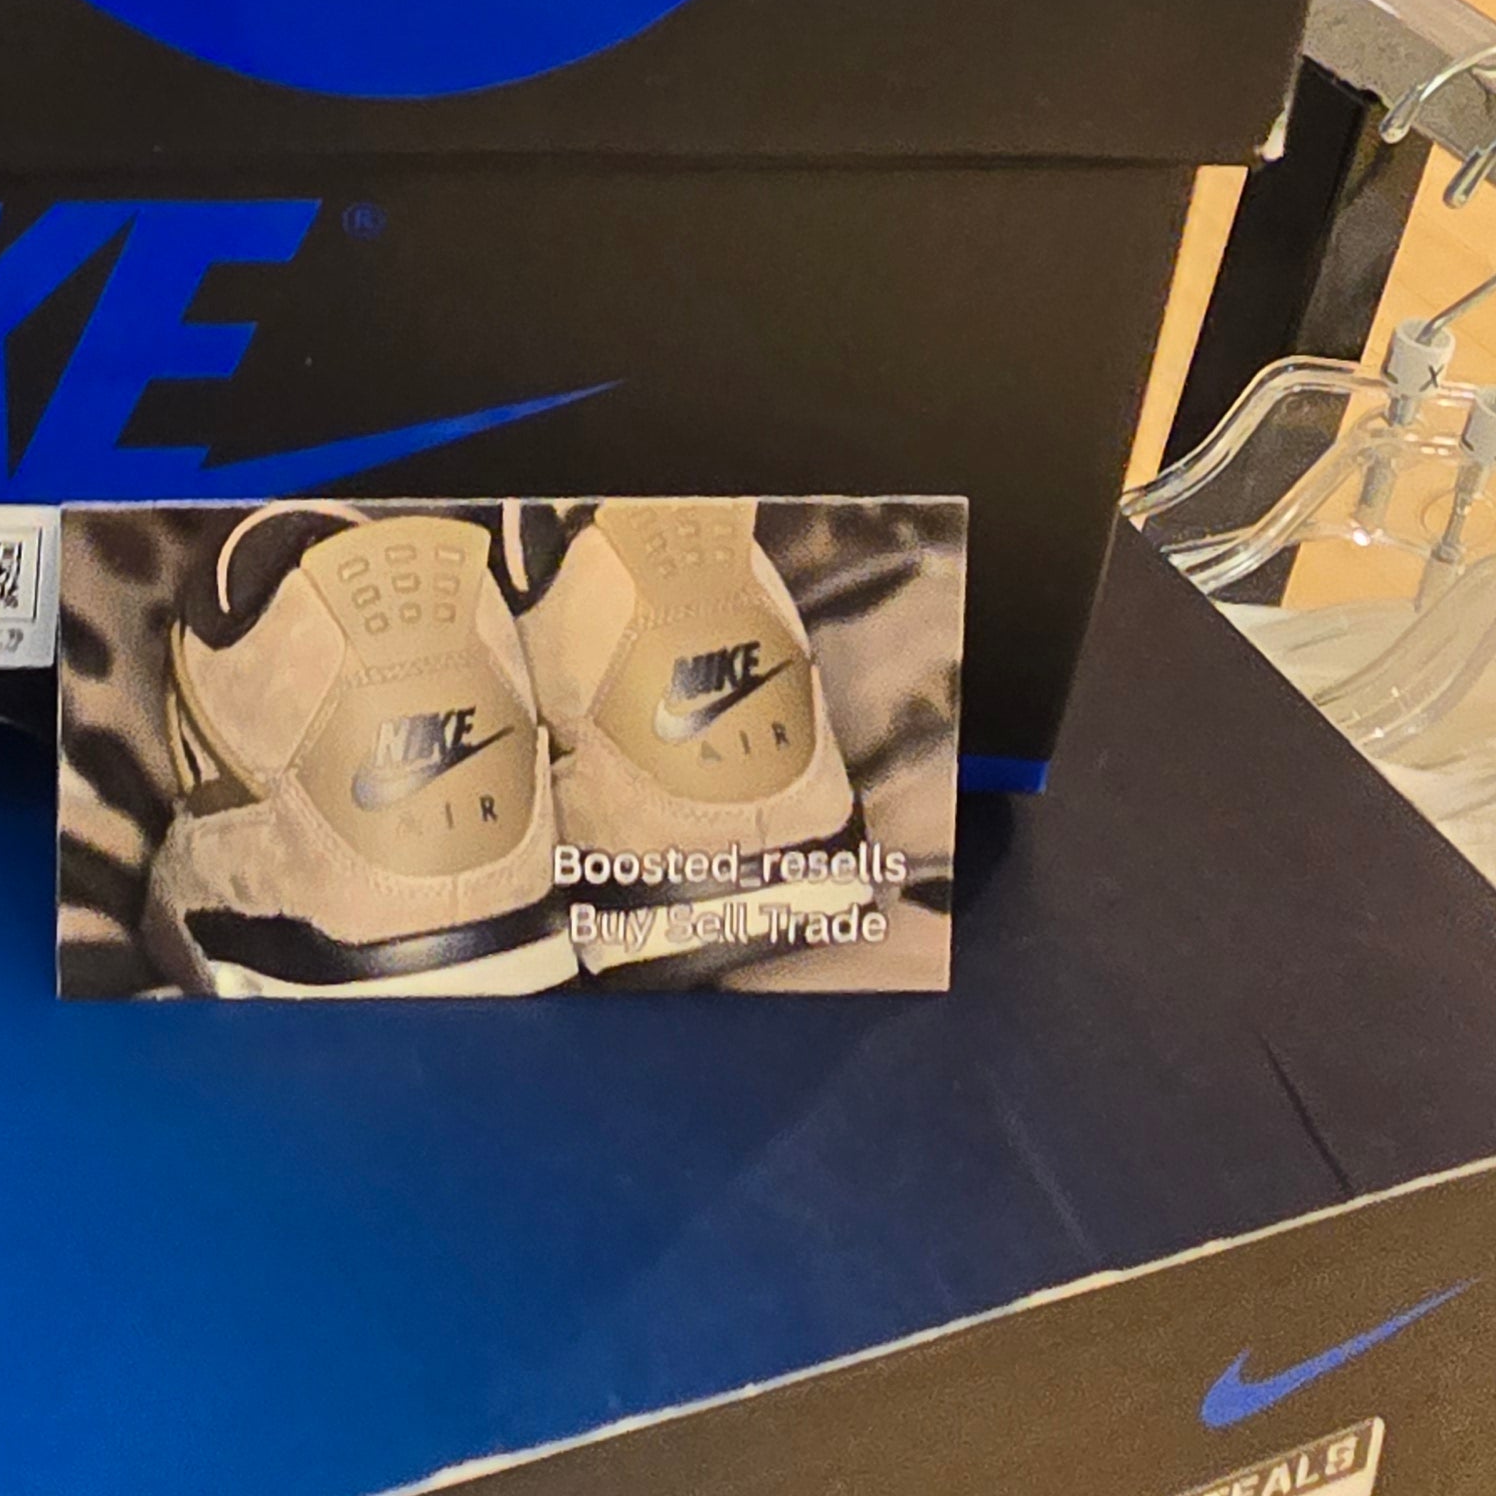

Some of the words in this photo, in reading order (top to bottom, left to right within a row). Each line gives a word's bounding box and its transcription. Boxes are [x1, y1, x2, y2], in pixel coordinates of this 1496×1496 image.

[669, 640, 761, 701] NIKE
[373, 705, 477, 769] NIKE
[570, 903, 656, 953] Buy
[664, 901, 750, 945] Sell
[758, 902, 888, 945] Trade
